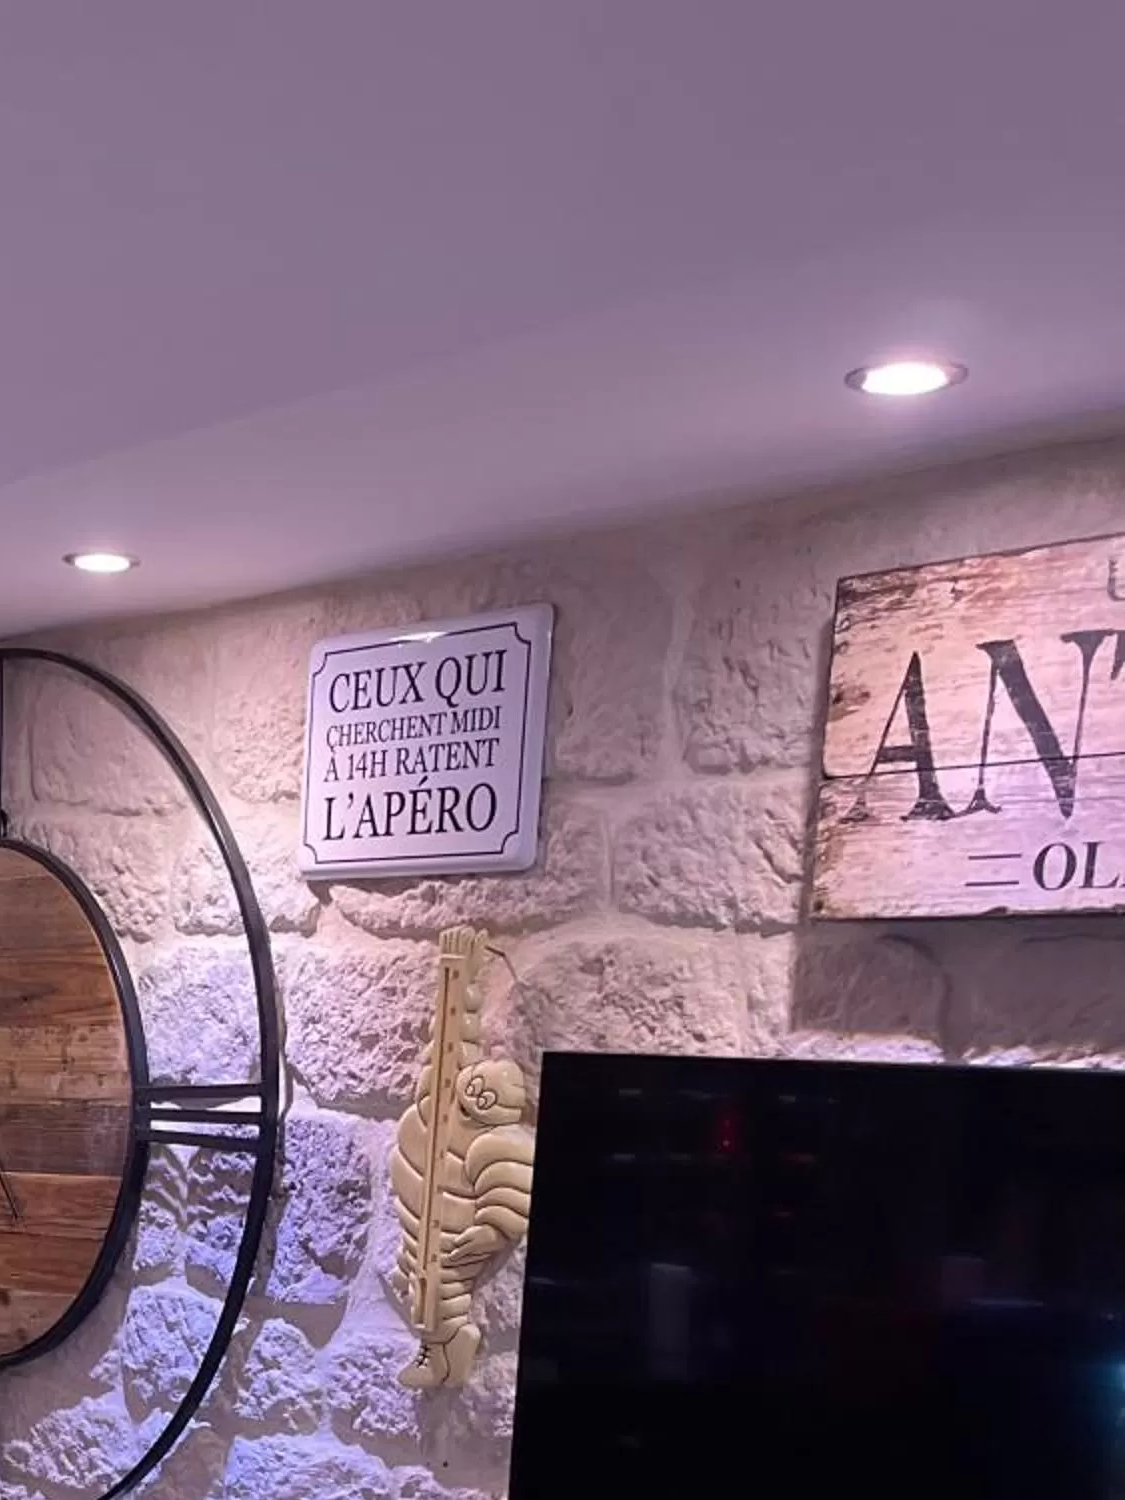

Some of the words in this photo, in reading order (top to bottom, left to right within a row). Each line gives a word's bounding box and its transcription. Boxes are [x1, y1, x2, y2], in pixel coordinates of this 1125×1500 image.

[328, 661, 427, 713] CEUX
[434, 650, 508, 708] QUI
[326, 711, 448, 747] CHERCHENT
[451, 705, 502, 734] MIDI
[840, 629, 1125, 822] AN
[346, 749, 387, 781] 14H
[395, 737, 500, 776] RATENT
[322, 775, 497, 841] L'APÉRO
[1032, 841, 1125, 891] OL
